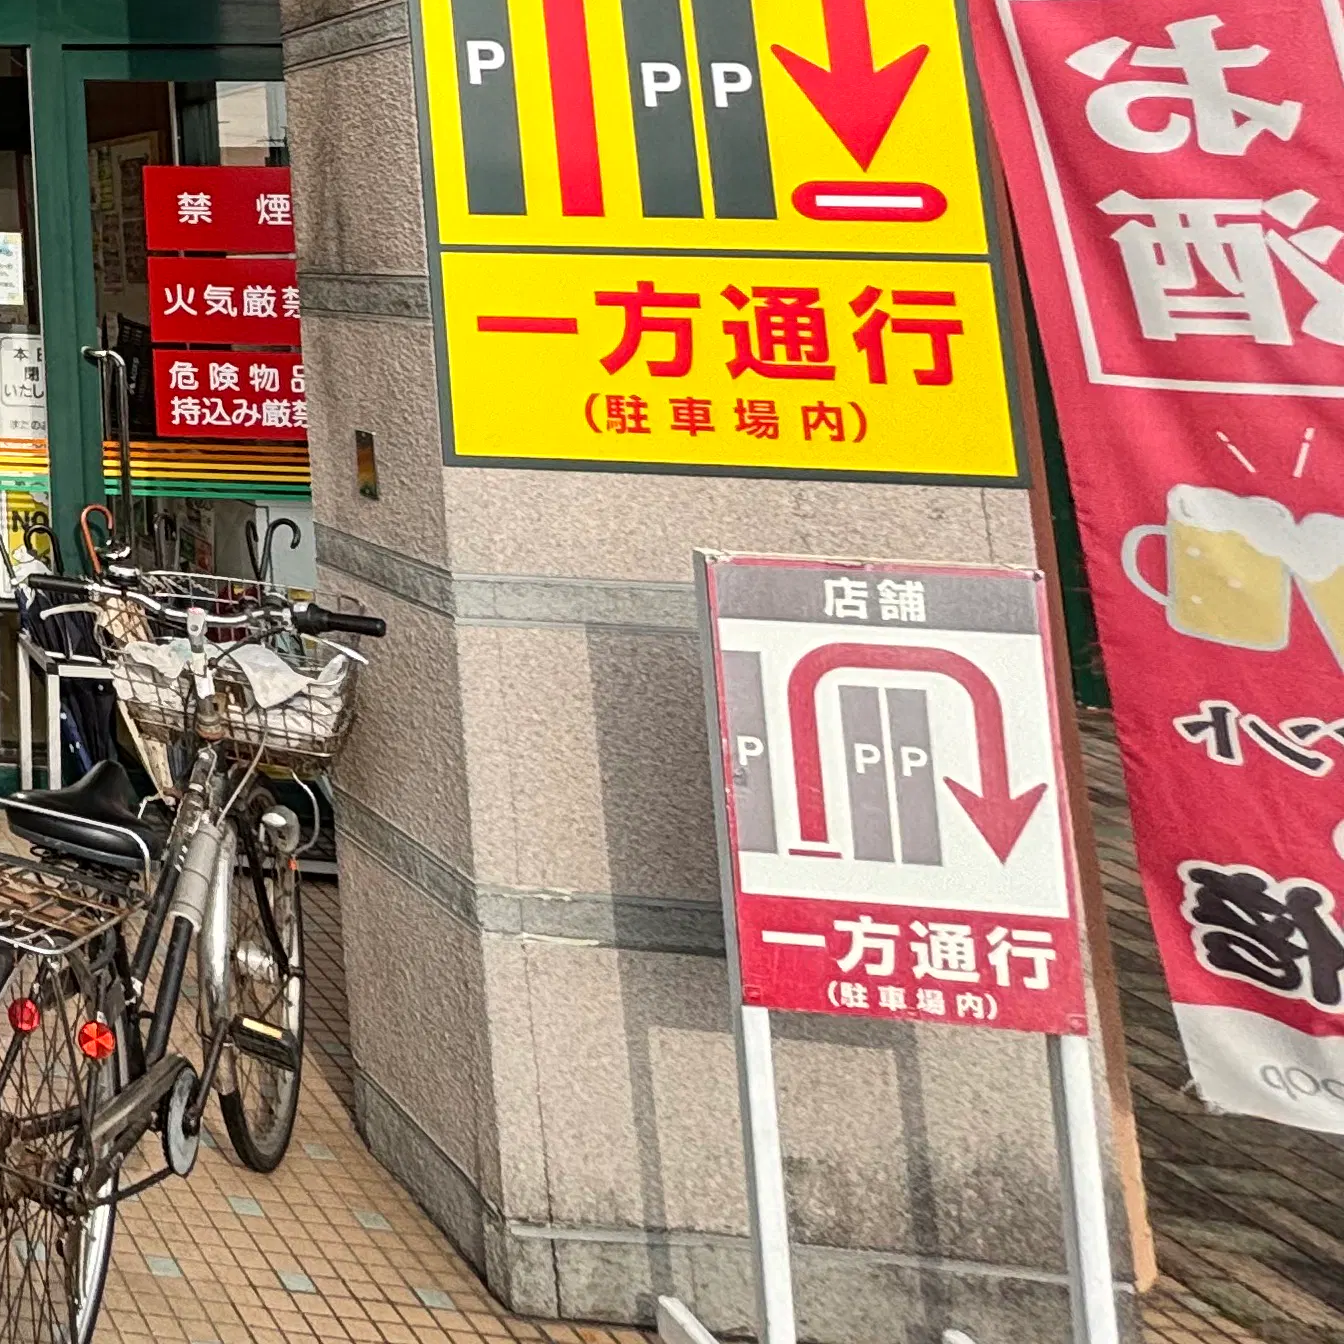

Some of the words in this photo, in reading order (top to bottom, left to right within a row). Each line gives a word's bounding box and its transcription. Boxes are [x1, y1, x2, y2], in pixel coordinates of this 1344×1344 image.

[466, 40, 506, 85] P
[642, 62, 682, 107] P
[712, 62, 754, 107] P
[177, 192, 293, 226] 禁煙
[476, 280, 965, 387] 一方通行
[584, 393, 868, 443] (駐車場内)
[823, 577, 927, 622] 店舗
[737, 735, 764, 766] P
[854, 743, 881, 774] P
[900, 746, 928, 777] P
[762, 915, 1056, 991] 一方通行
[828, 980, 999, 1020] (駐車場内)
